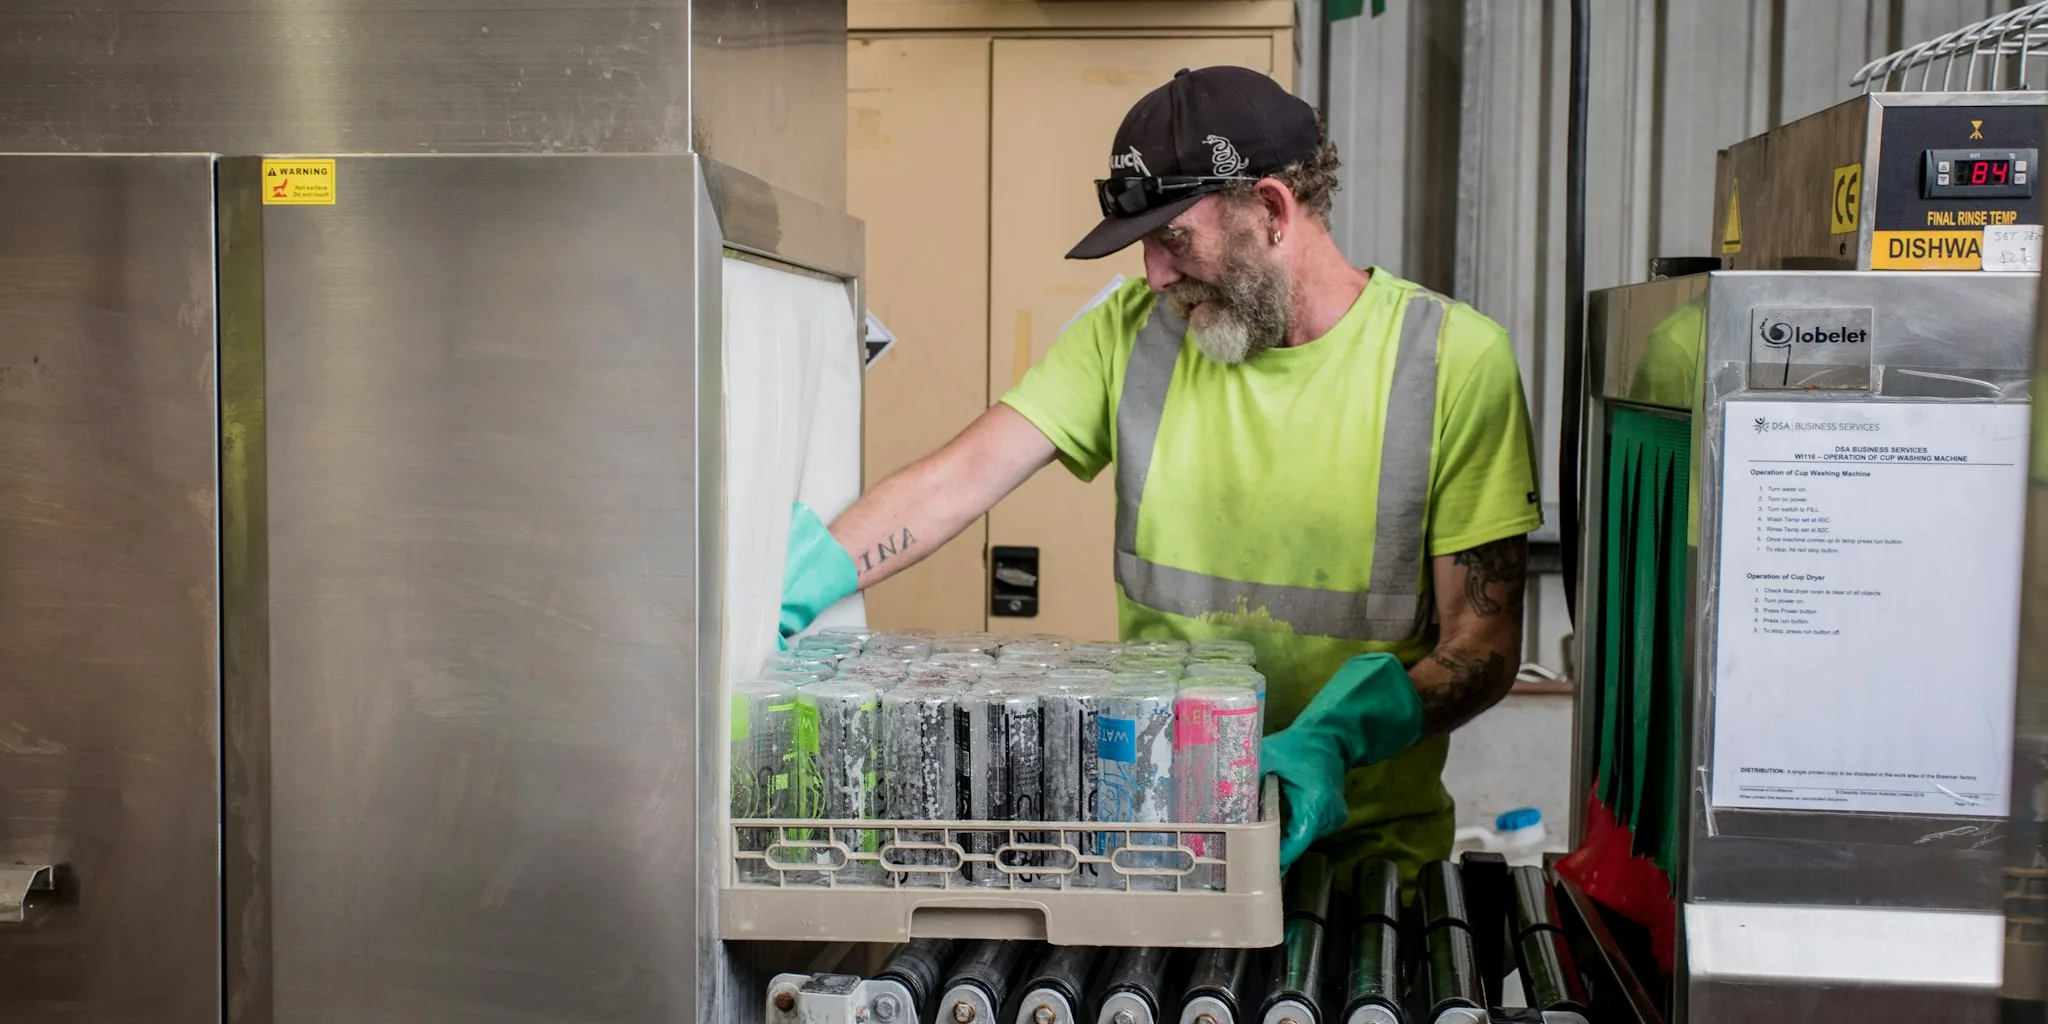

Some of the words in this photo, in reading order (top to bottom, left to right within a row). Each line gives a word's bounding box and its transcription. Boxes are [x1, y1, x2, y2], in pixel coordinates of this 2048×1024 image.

[1972, 161, 2008, 184] 84
[1835, 172, 1858, 225] CE
[1927, 211, 1956, 226] FINAL
[1958, 211, 1987, 226] RINSE
[1989, 210, 2017, 225] TEMP
[1889, 238, 1982, 259] DISHWA
[1772, 422, 1790, 430] DSA
[1795, 422, 1836, 430] BUSINESS
[1839, 423, 1880, 431] SERVICES
[858, 527, 915, 577] INA
